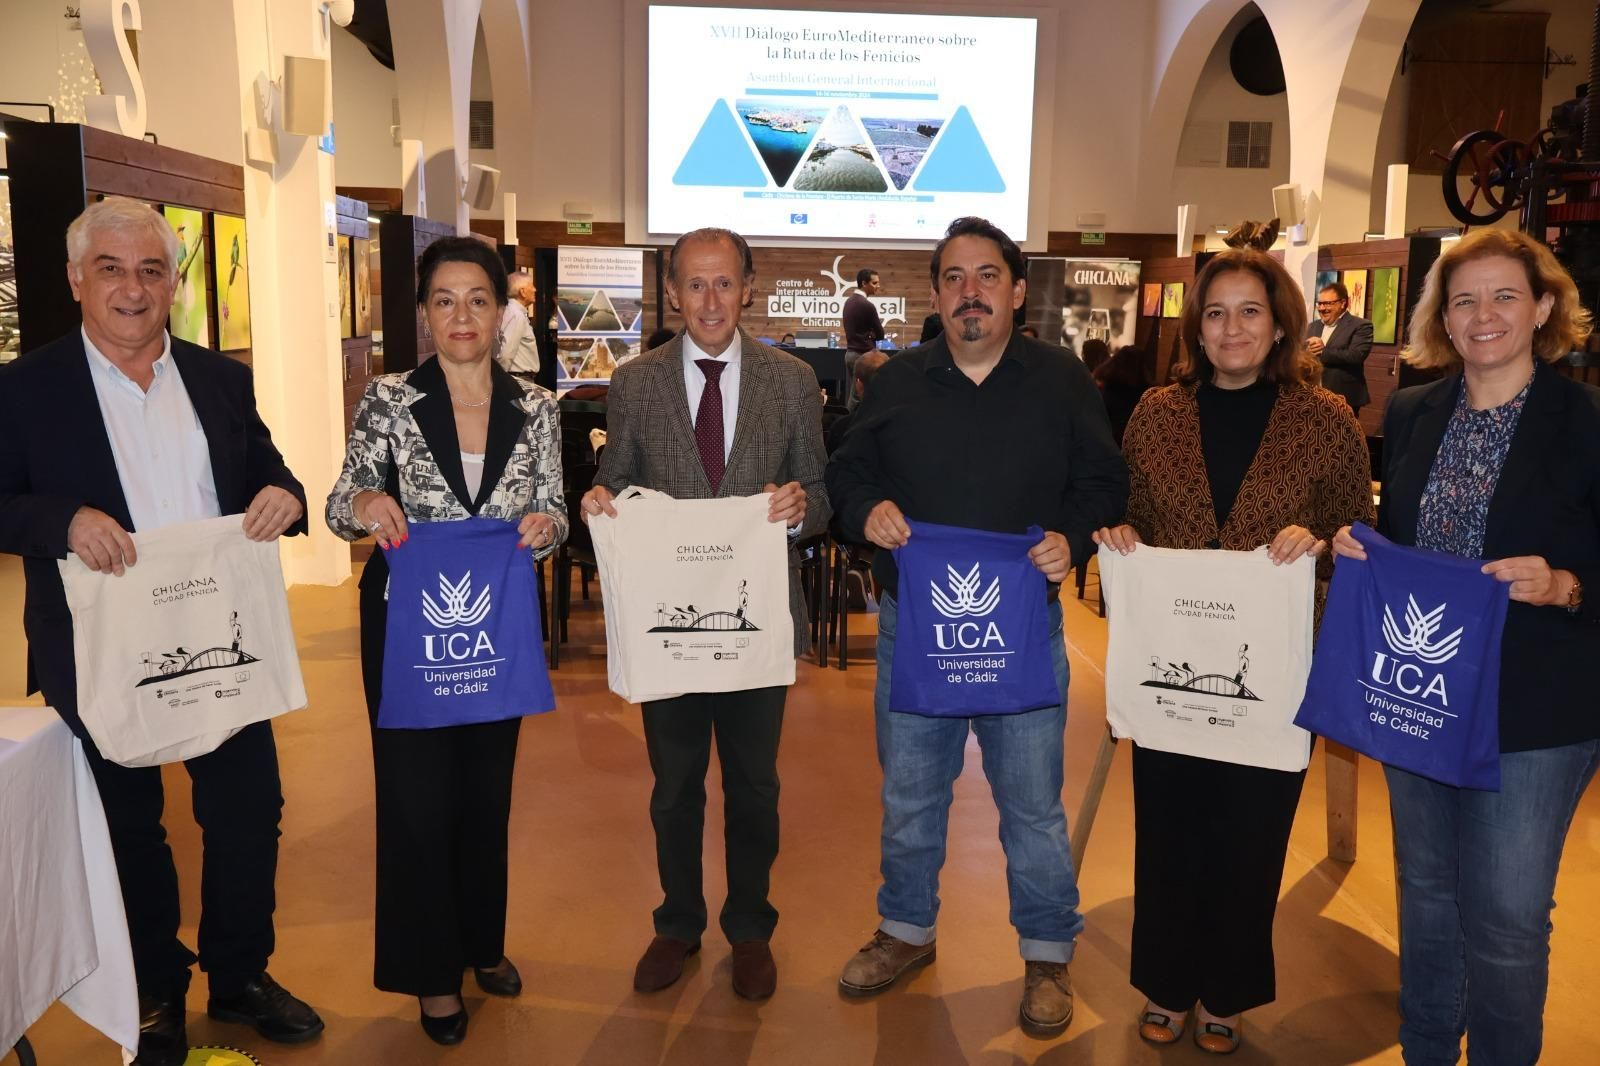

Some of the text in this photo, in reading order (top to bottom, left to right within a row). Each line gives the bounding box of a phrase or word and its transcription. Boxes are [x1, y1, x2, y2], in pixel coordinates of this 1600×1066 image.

[710, 25, 977, 46] XVII Diálogo EuroMediterraneo sobre
[767, 46, 921, 64] la Ruta de los Fenicios
[746, 71, 937, 88] Asamblea General Internacional
[776, 278, 814, 288] Centro de
[1073, 269, 1131, 286] CHICLANA
[776, 287, 830, 297] Interpretación
[770, 296, 903, 315] del vino sal
[676, 544, 734, 554] CHICLANA
[152, 576, 217, 597] CHICLANA
[153, 586, 219, 606] CIUDAD FENICIA
[1174, 598, 1236, 613] CHICLANA
[1173, 609, 1236, 621] CIUDAD FENICIA
[932, 621, 1006, 650] UCA
[422, 630, 496, 662] UCA
[937, 657, 1006, 670] Universidad
[424, 665, 497, 683] Universidad
[947, 671, 998, 683] de Cádiz
[1371, 650, 1448, 707] UCA
[434, 681, 489, 696] de Cádiz
[1365, 690, 1444, 729] Universidad
[1369, 711, 1430, 741] de Cádiz
